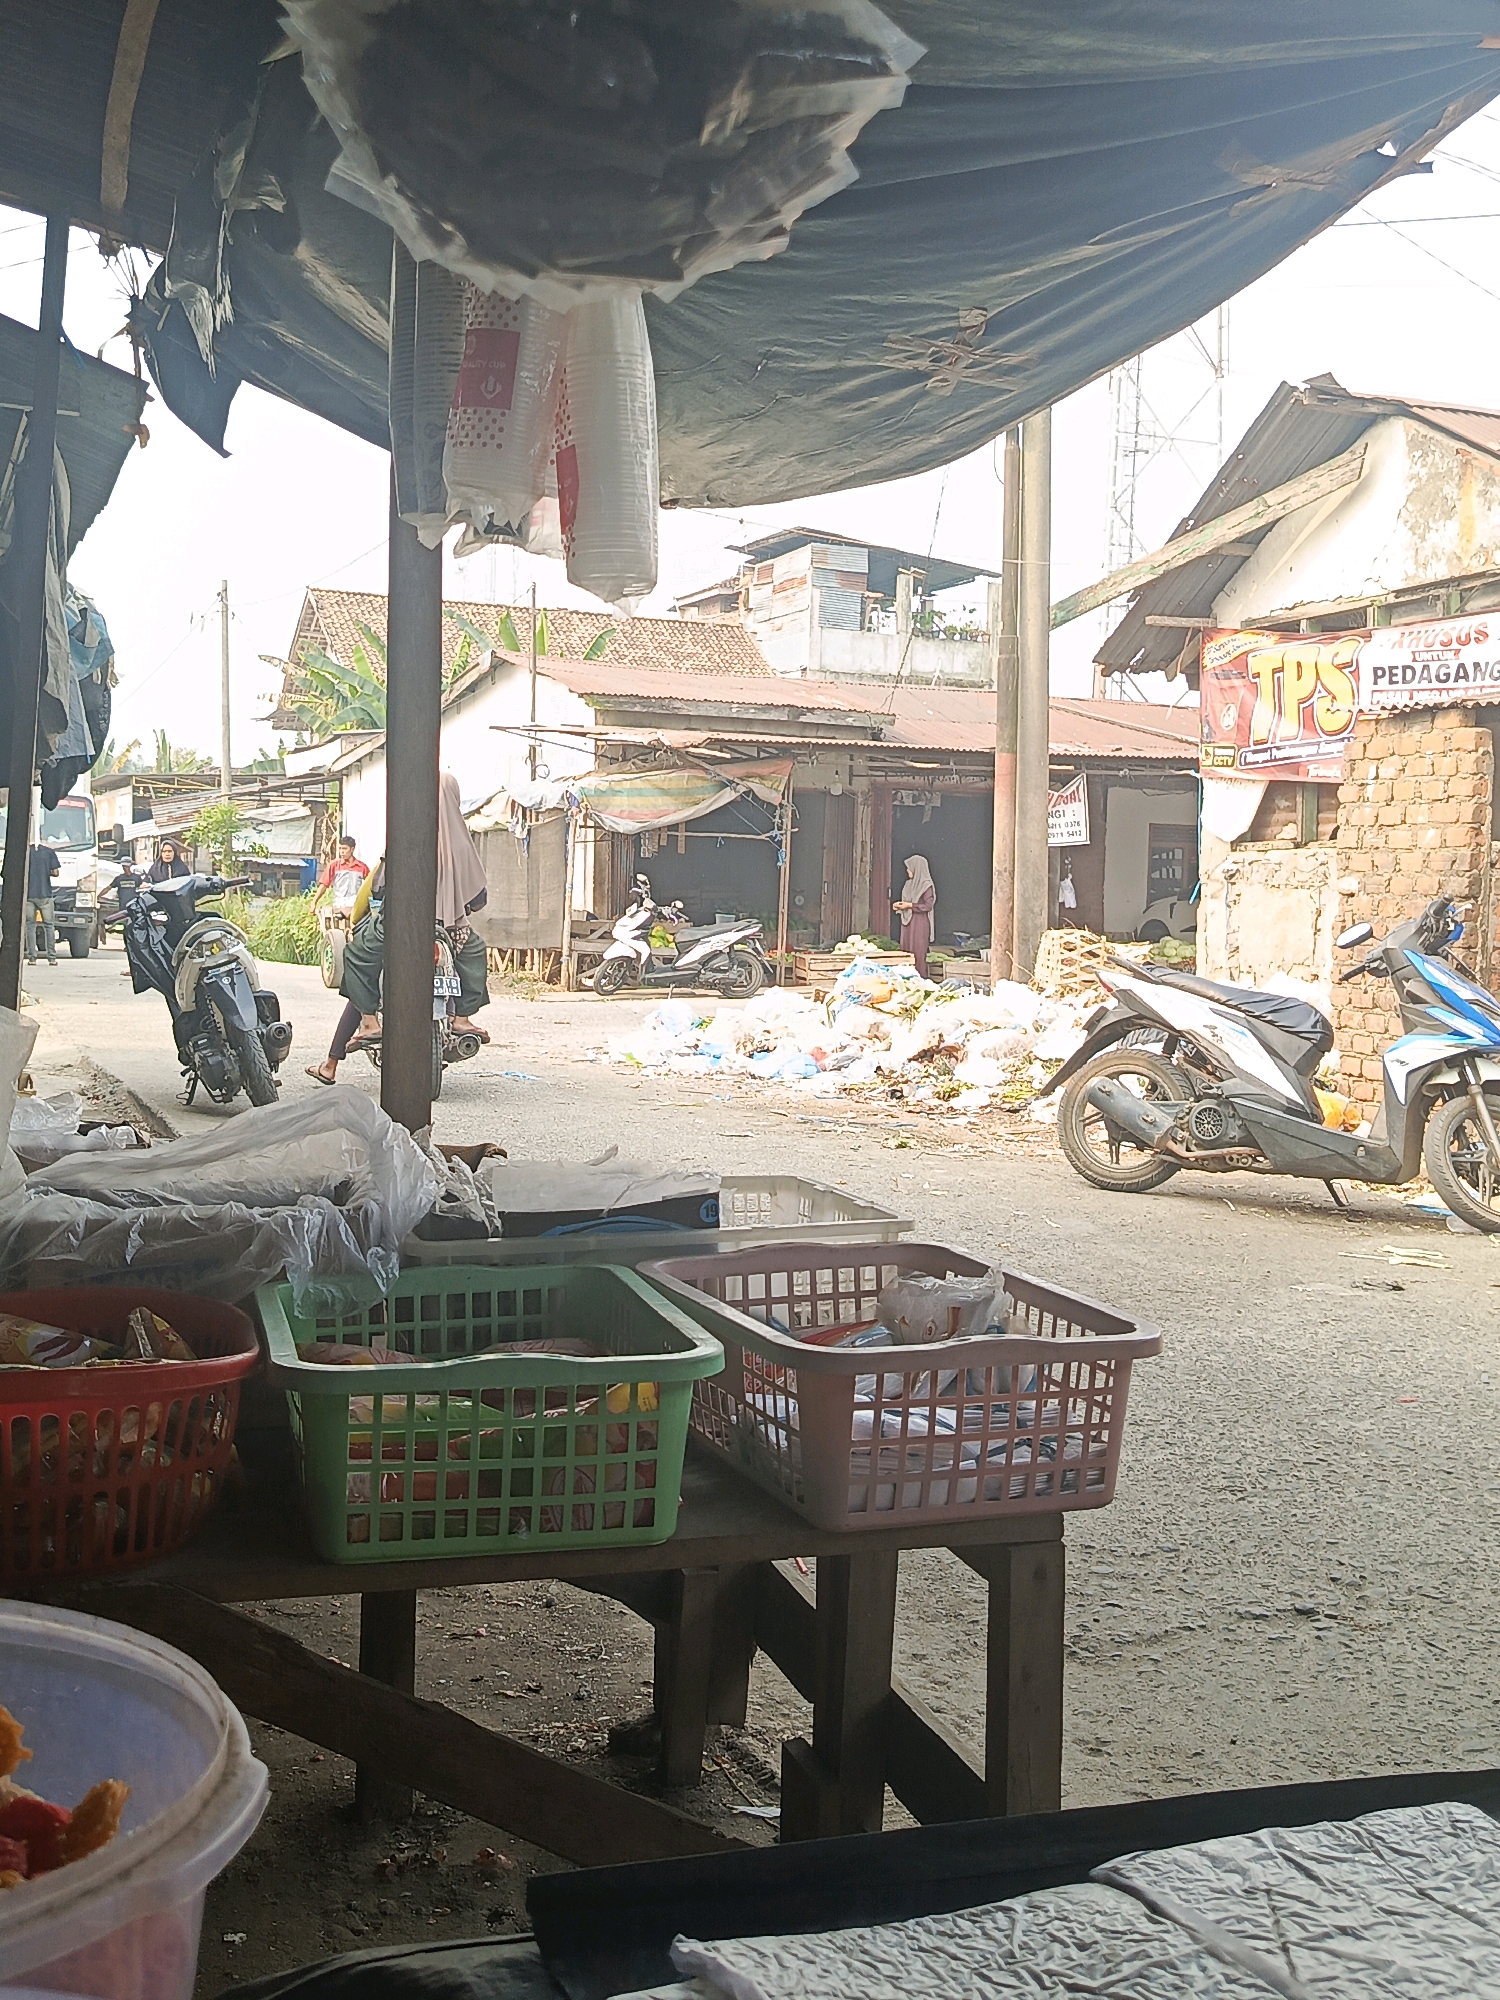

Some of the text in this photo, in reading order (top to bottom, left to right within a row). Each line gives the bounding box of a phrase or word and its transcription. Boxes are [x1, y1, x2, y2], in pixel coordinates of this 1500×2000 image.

[1391, 622, 1489, 649] KHUSUS
[1414, 651, 1457, 661] UNTUK
[1372, 660, 1500, 686] PEDAGANG
[1250, 638, 1363, 745] TPS
[1214, 756, 1234, 766] CCTV
